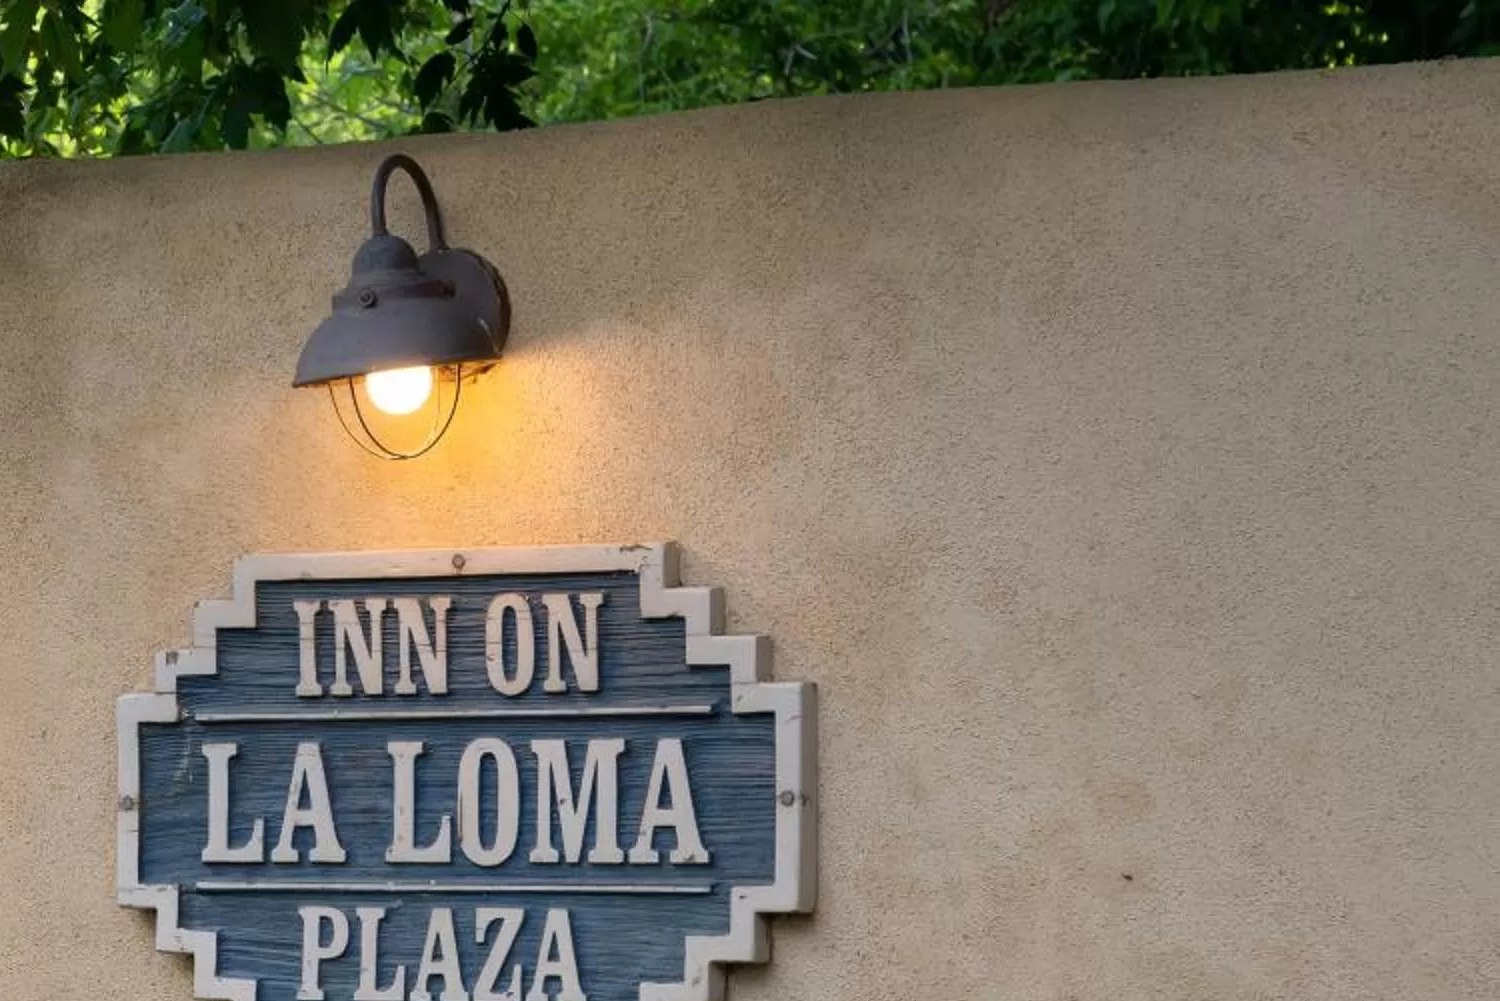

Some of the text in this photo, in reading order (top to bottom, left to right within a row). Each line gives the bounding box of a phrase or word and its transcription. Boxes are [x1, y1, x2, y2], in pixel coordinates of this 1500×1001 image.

[293, 592, 604, 698] INN ON
[201, 737, 711, 867] LA LOMA
